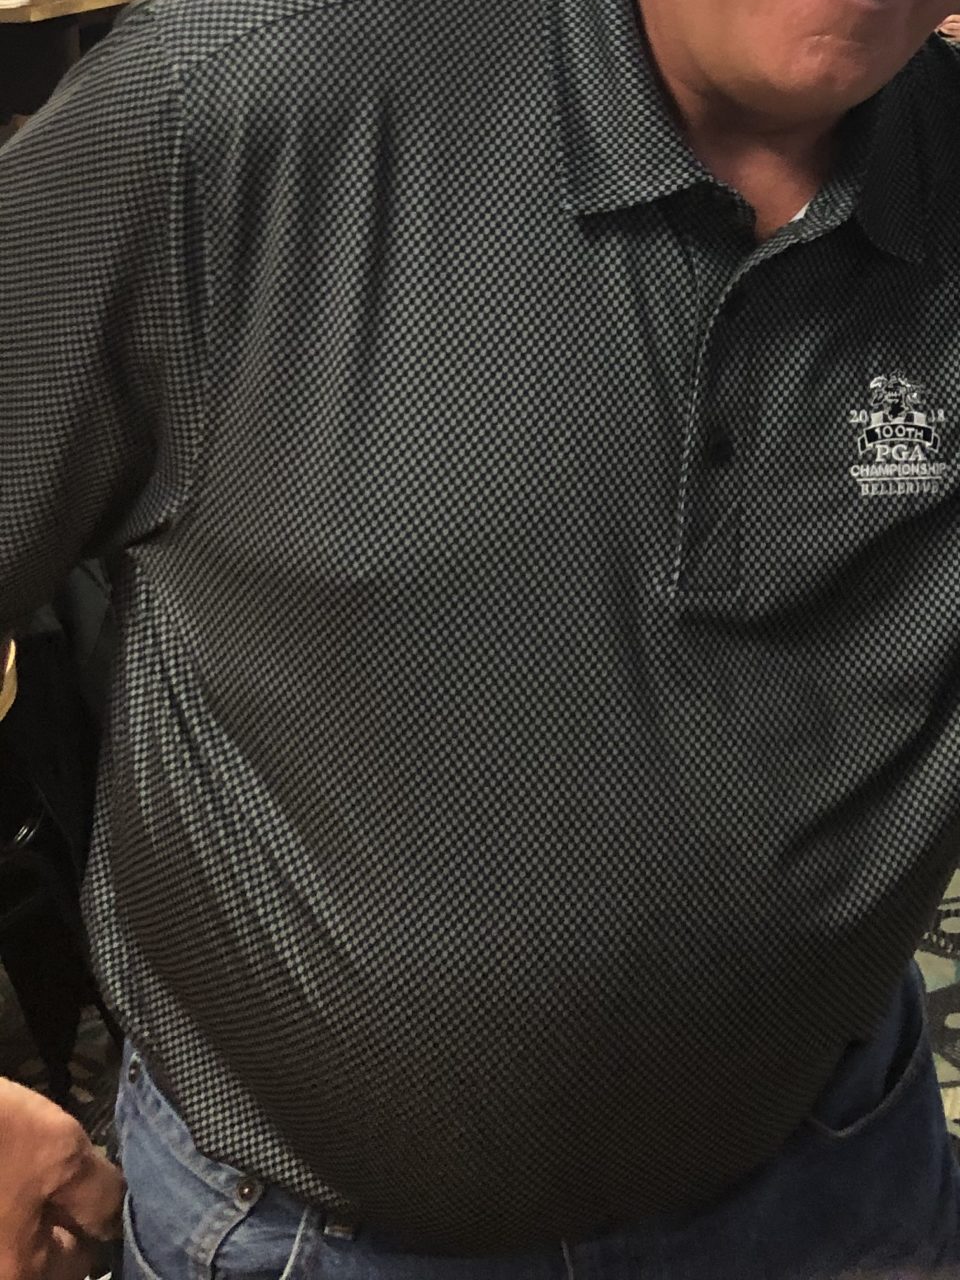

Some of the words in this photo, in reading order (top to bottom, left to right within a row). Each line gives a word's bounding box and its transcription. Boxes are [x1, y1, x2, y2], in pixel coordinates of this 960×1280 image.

[849, 409, 868, 423] 20
[931, 409, 945, 422] 18
[874, 425, 924, 439] 100TH
[875, 444, 927, 462] PGA
[850, 463, 946, 477] CHAMPIONSHIP
[860, 481, 939, 496] BELLERIVE
